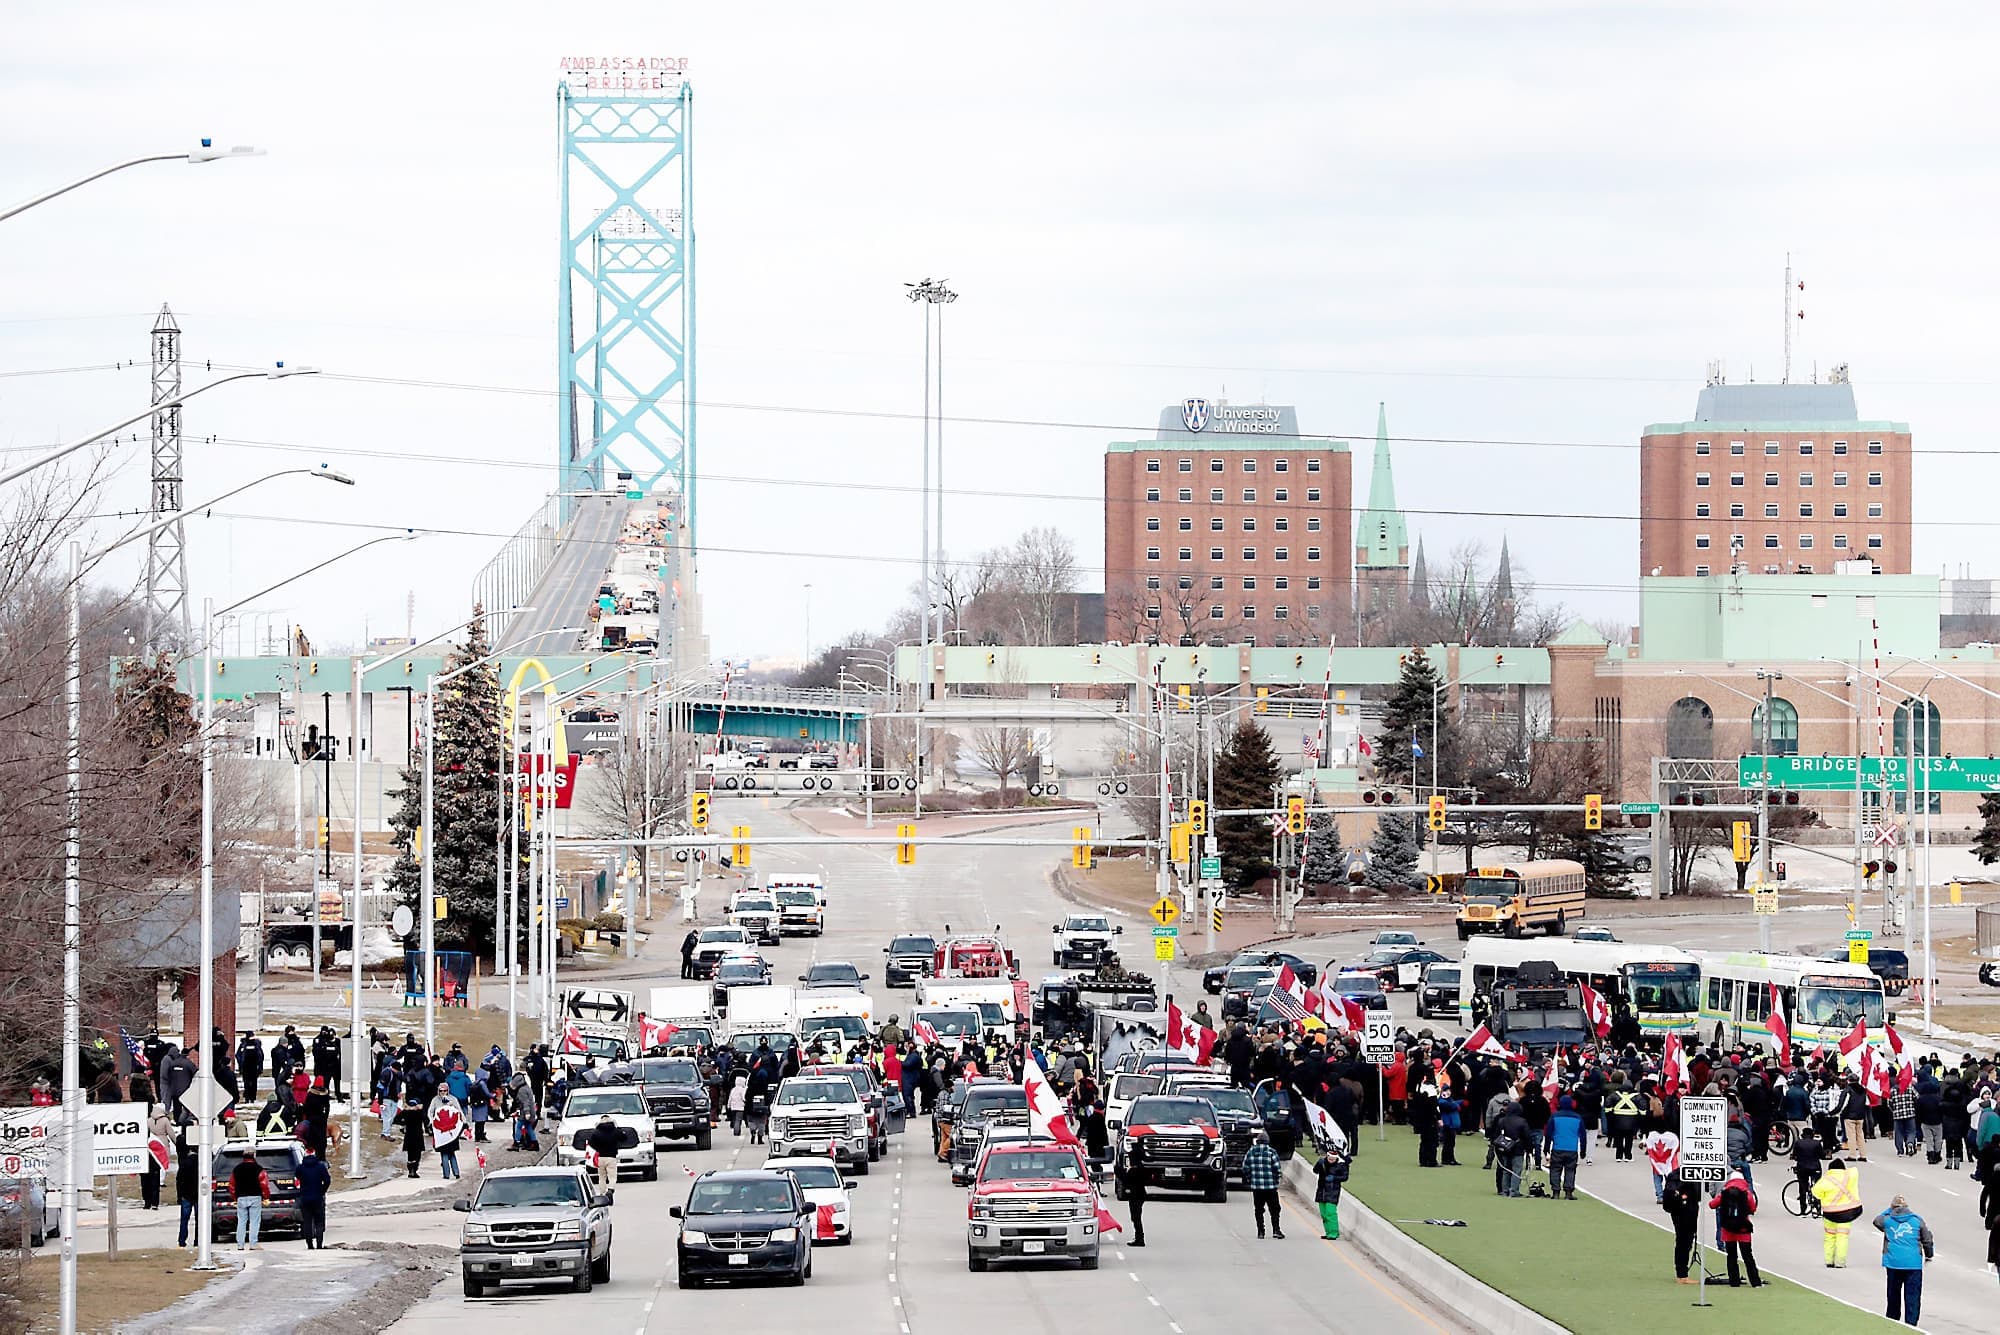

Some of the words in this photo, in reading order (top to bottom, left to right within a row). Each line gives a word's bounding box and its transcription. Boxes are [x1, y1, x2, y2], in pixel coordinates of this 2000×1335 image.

[560, 57, 689, 70] AMBASSADOR
[588, 77, 661, 89] BRIDGE
[1213, 406, 1280, 422] University
[1214, 424, 1223, 432] of
[1224, 420, 1280, 432] Windsor
[1791, 759, 1857, 771] BRIDGE
[1878, 759, 1898, 771] TO
[1918, 759, 1965, 772] U.S.A.
[1622, 804, 1651, 813] College
[1863, 830, 1874, 838] 50
[1845, 931, 1867, 939] College
[1647, 963, 1677, 972] SPECIAL
[1369, 1024, 1390, 1039] 50
[1367, 1054, 1394, 1062] BEGINS
[1684, 1102, 1724, 1111] COMMUNITY
[1691, 1114, 1717, 1123] SAFETY
[1694, 1126, 1713, 1136] ZONE
[1694, 1141, 1714, 1150] FINES
[1683, 1152, 1724, 1162] INCREASED
[1684, 1168, 1722, 1180] ENDS
